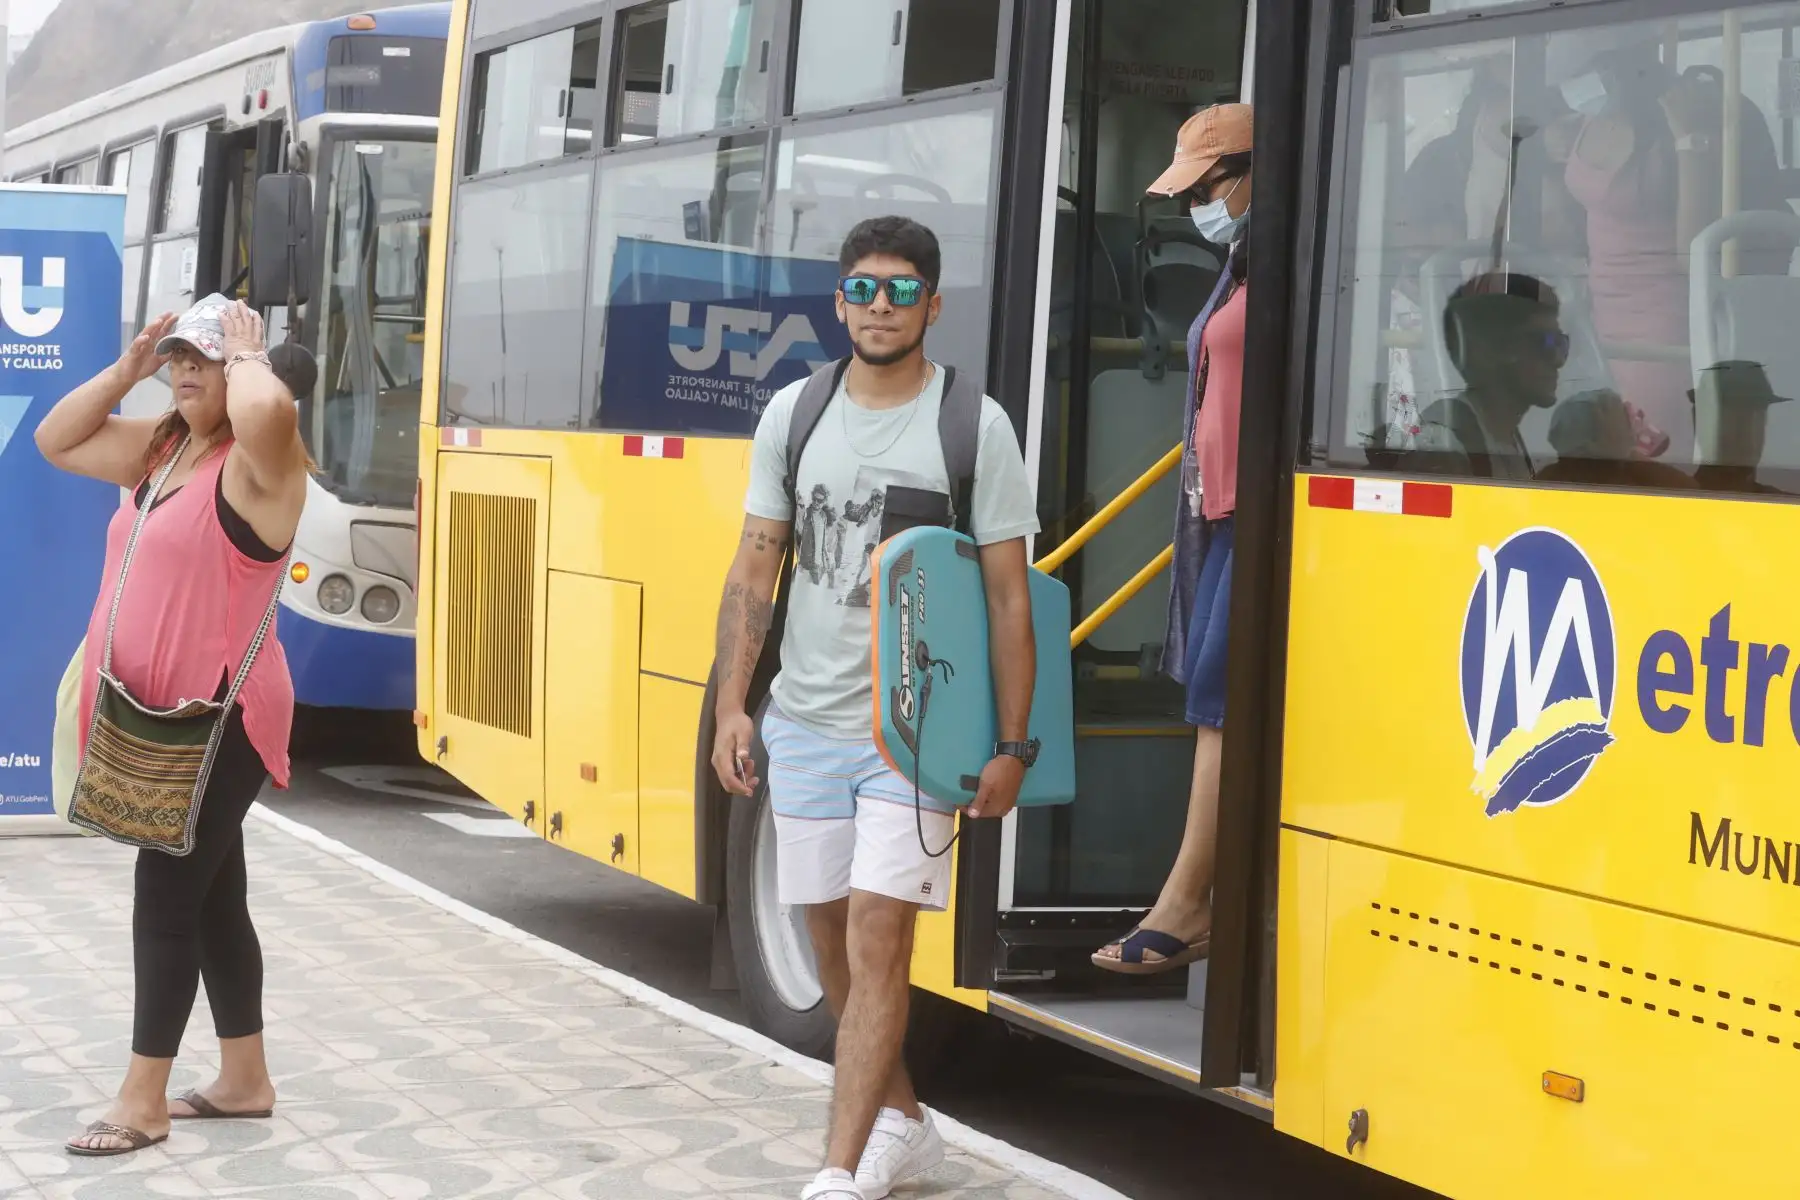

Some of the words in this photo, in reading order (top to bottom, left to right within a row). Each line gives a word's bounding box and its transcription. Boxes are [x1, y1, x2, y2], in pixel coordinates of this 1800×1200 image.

[2, 357, 11, 369] Y
[13, 358, 63, 370] CALLAO
[899, 583, 915, 721] SUNSET
